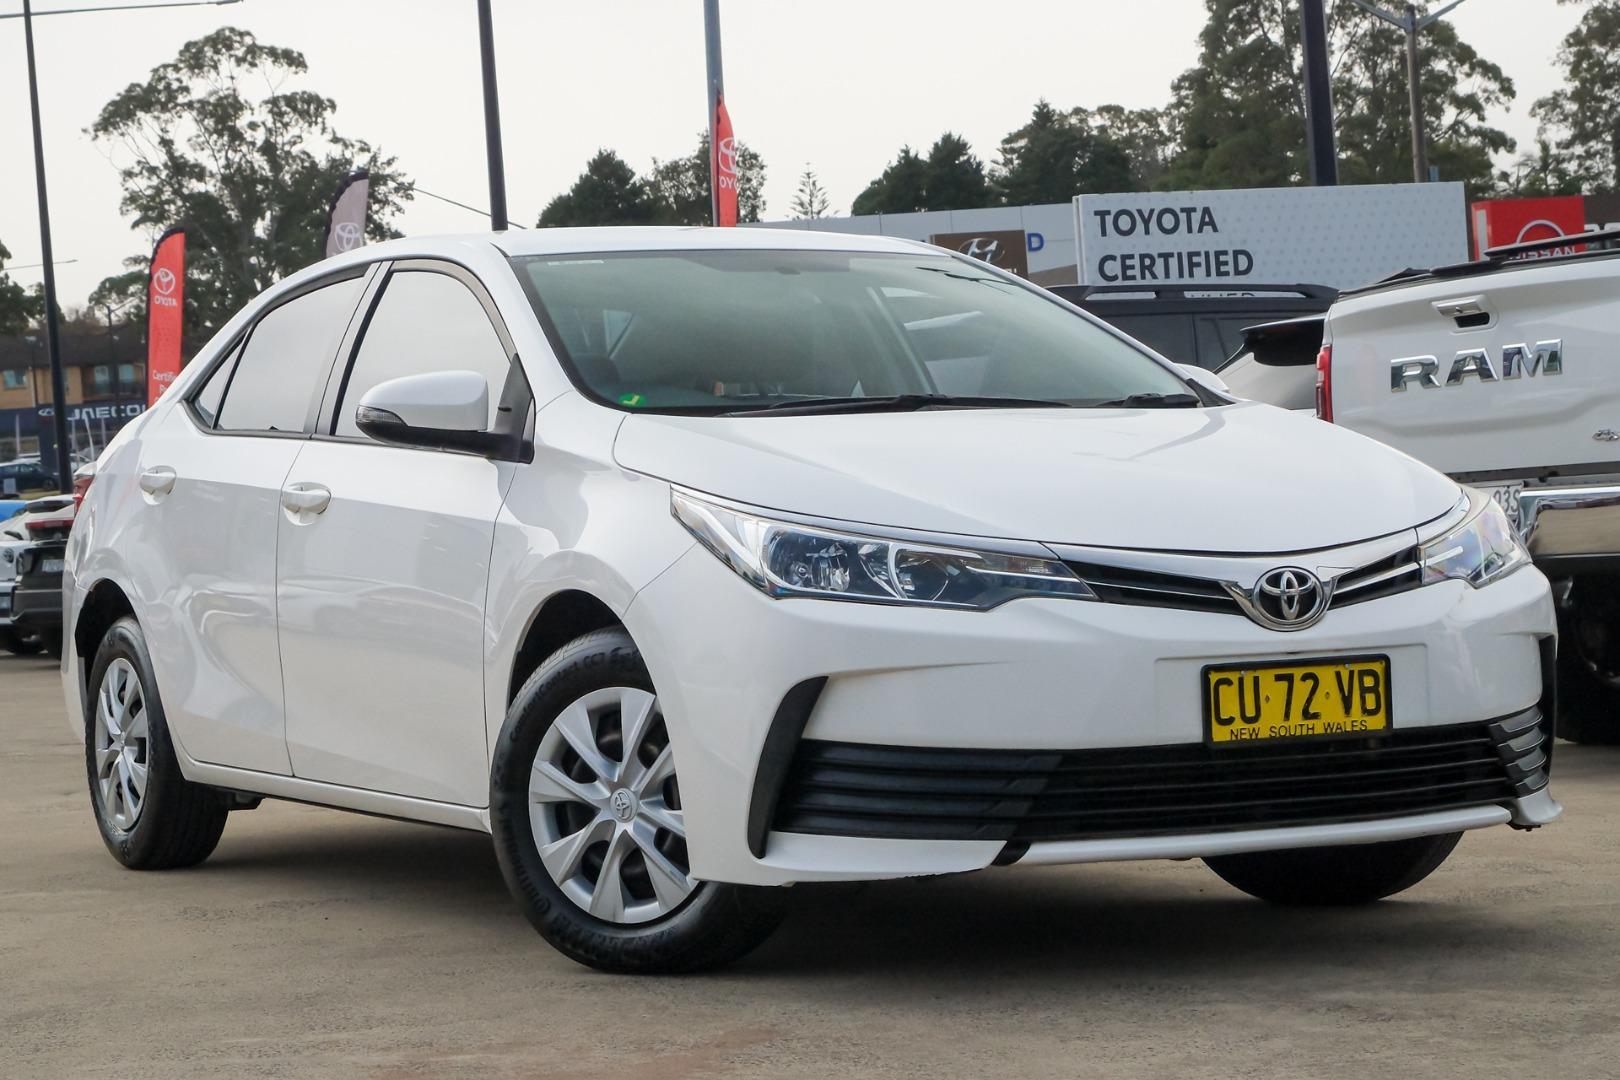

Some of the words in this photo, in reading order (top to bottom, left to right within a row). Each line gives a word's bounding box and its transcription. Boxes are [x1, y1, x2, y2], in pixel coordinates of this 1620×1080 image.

[1093, 206, 1219, 237] TOYOTA
[1098, 249, 1254, 282] CERTIFIED
[1390, 338, 1563, 393] RAM
[67, 404, 147, 421] JAECO
[1213, 675, 1262, 726] CU
[1274, 672, 1321, 722] 72
[1335, 669, 1382, 718] VB
[1230, 727, 1261, 741] NEW
[1269, 723, 1316, 737] SOUTH
[1323, 719, 1368, 733] WALES
